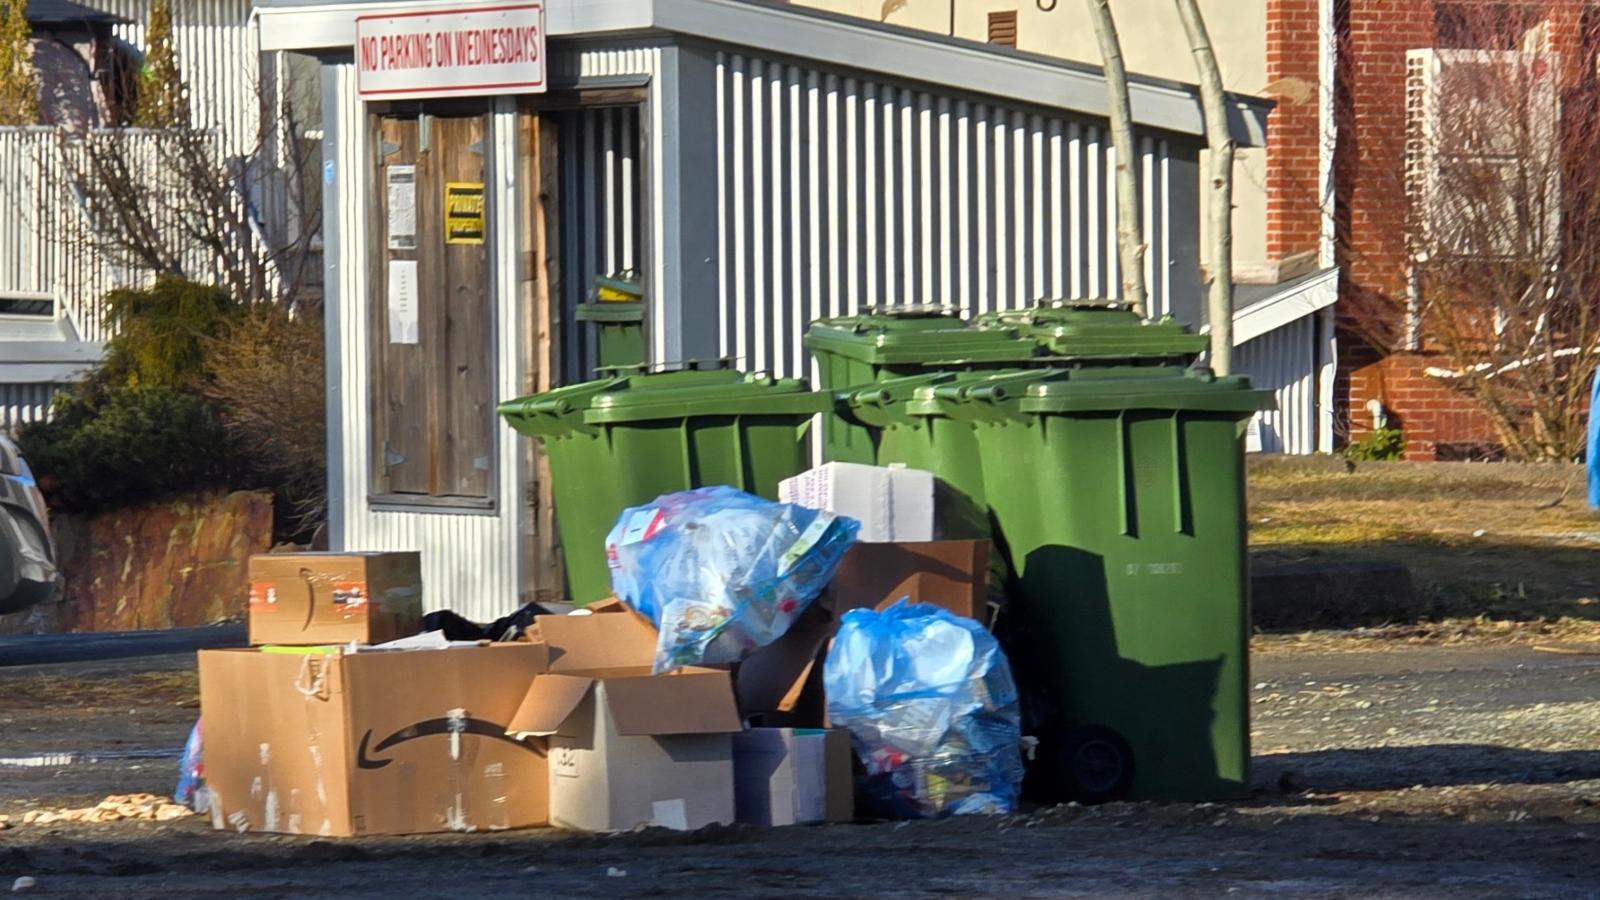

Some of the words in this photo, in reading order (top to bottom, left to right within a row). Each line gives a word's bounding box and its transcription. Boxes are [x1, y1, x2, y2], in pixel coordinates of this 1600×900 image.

[361, 36, 377, 71] NO
[381, 33, 432, 70] PARKING
[435, 31, 452, 67] ON
[455, 26, 537, 66] WEDNESDAYS
